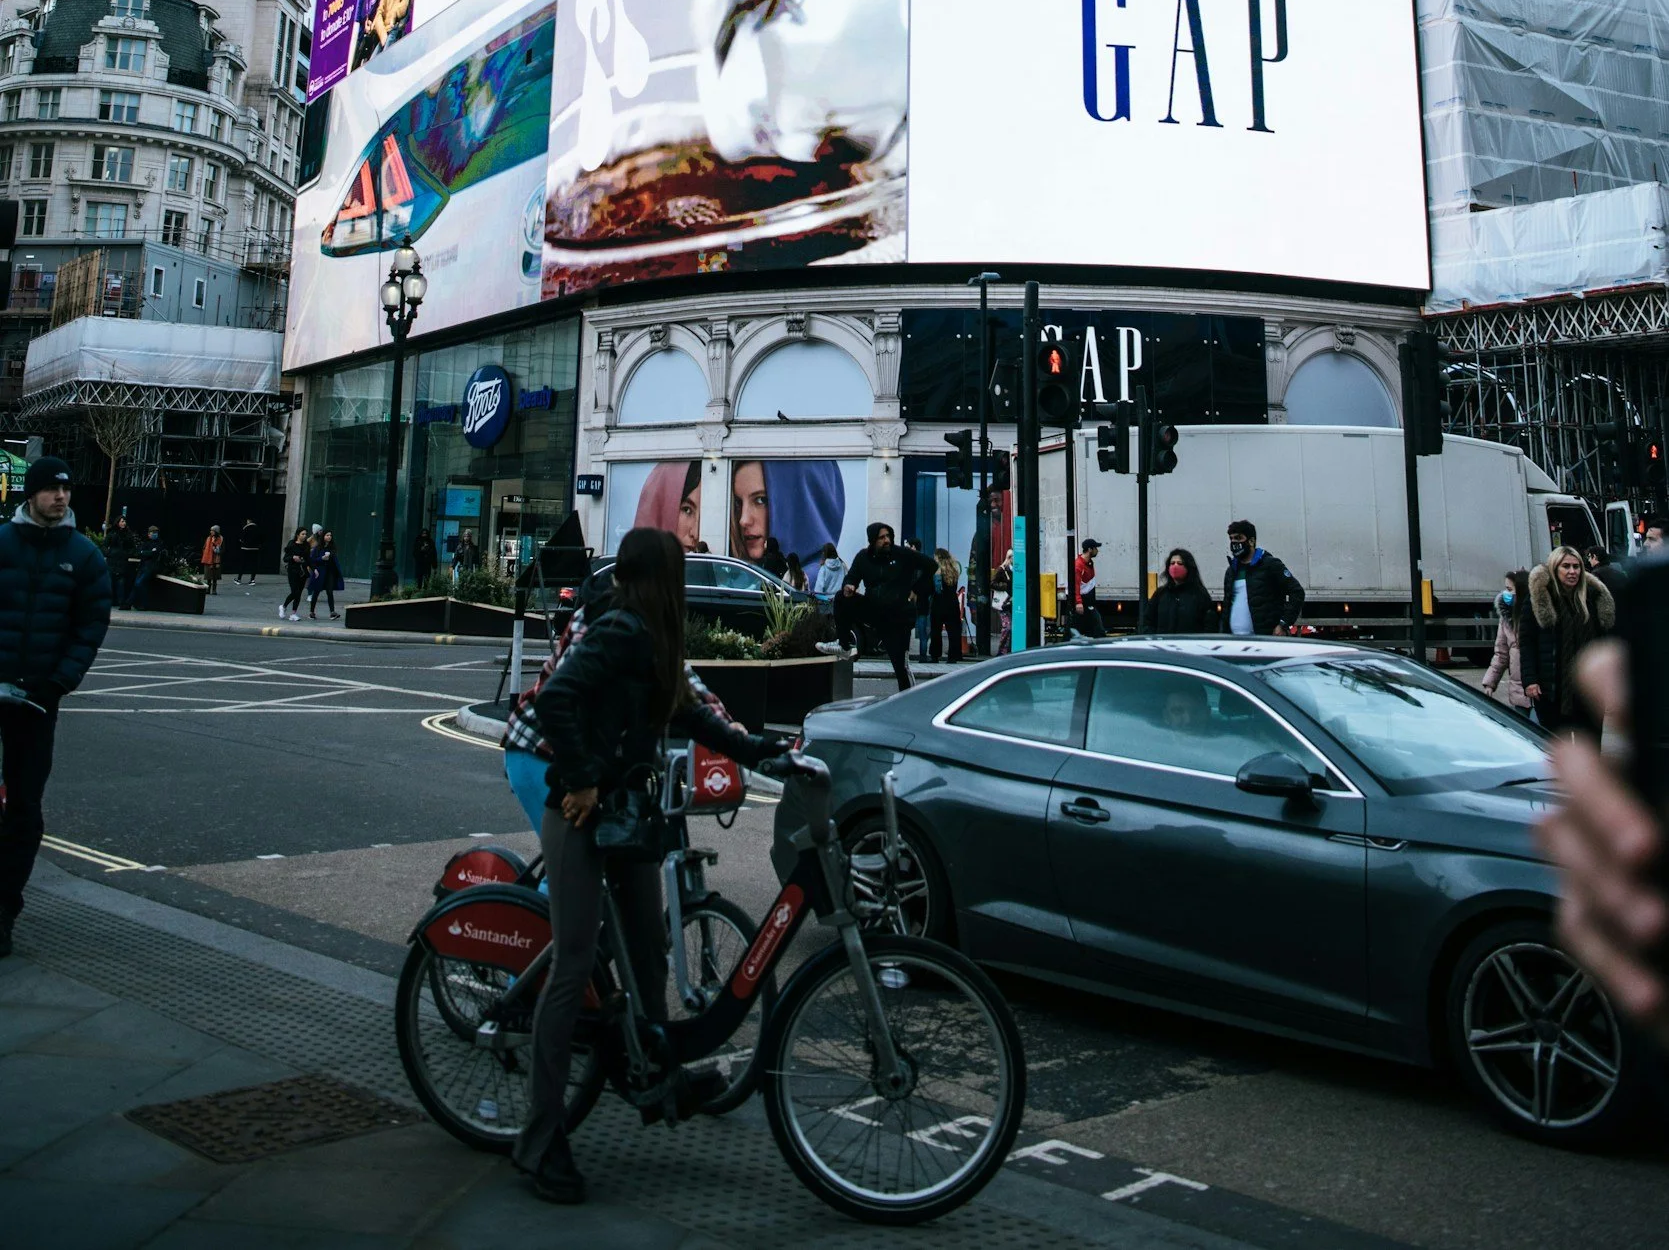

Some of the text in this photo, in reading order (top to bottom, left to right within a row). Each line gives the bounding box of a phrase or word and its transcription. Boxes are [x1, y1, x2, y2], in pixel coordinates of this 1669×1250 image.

[325, 16, 343, 38] donate
[1040, 324, 1142, 404] AP
[463, 377, 503, 435] Boots
[519, 386, 552, 410] beauty
[578, 479, 601, 491] GAP GAP
[465, 869, 502, 885] Santand
[463, 922, 533, 950] Santander
